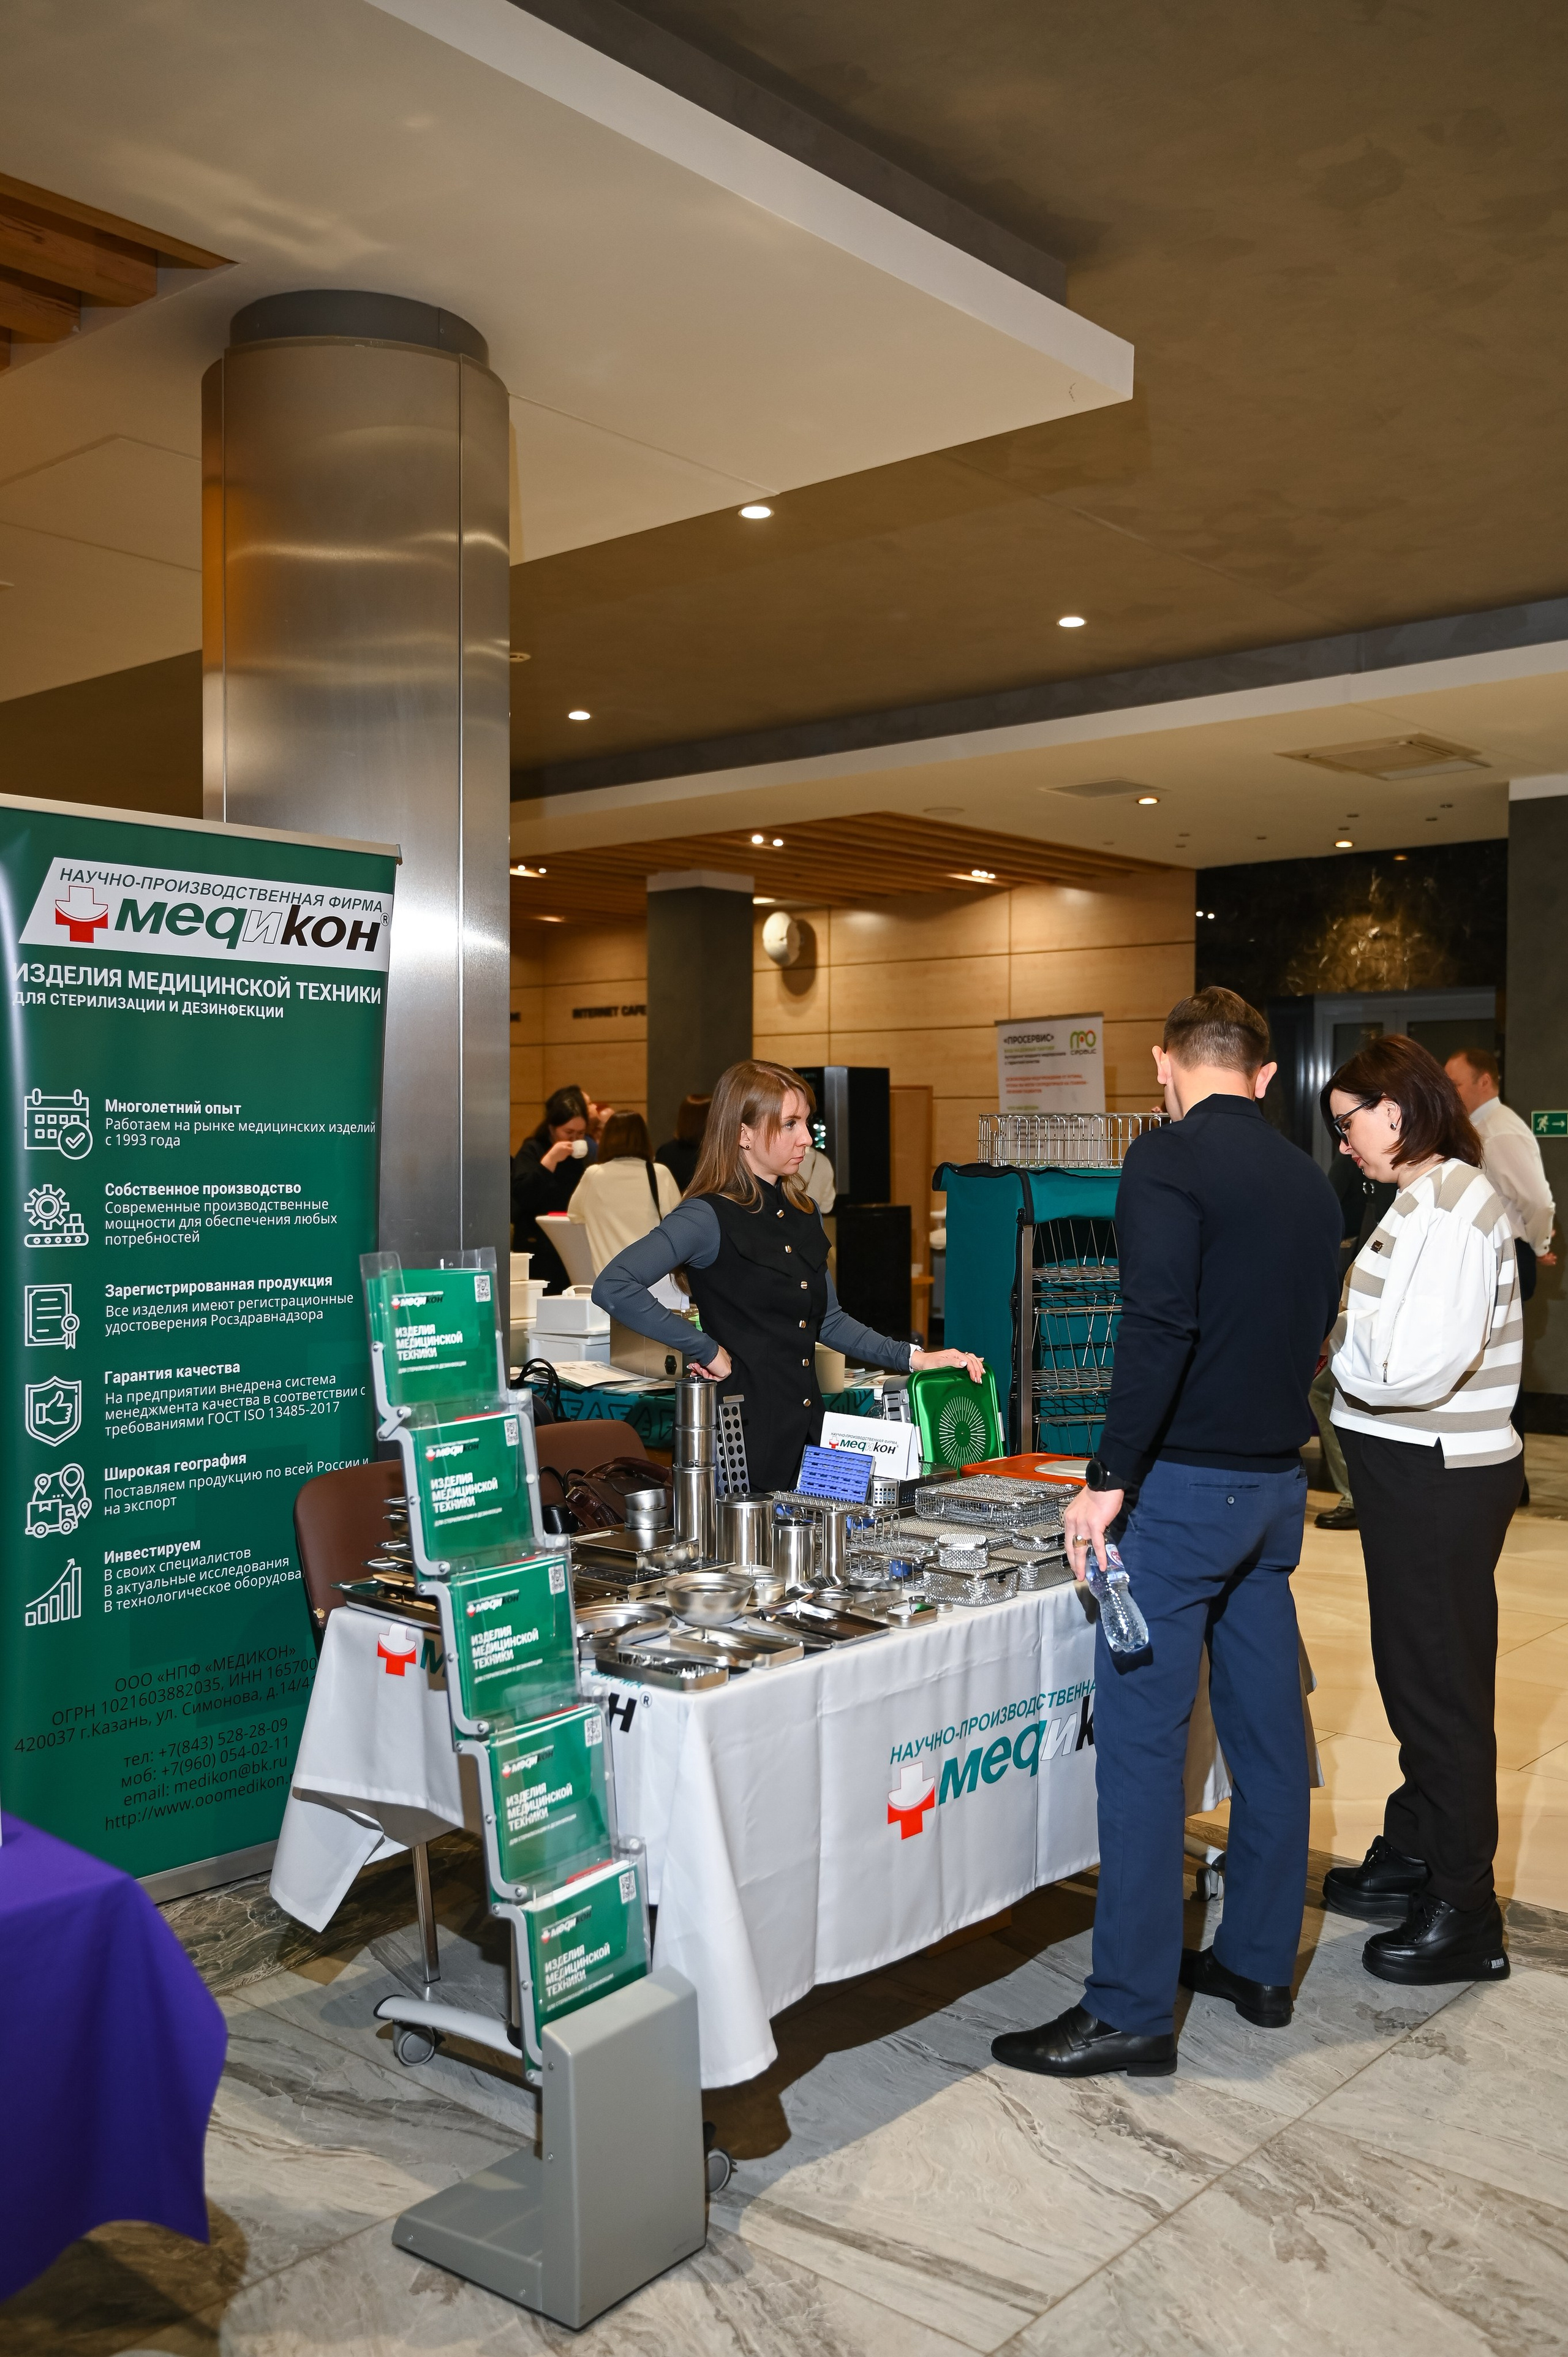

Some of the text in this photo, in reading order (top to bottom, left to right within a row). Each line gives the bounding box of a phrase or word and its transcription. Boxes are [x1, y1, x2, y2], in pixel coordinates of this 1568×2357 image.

[60, 868, 382, 913] НАУЧНО-ПРОИЗВОДСТВЕННАЯ ФИРМА
[13, 963, 380, 1004] ИЗДЕЛИЯ МЕДИЦИНСКОЙ ТЕХНИКИ
[12, 992, 283, 1019] ДЛЯ СТЕРИЛИЗАЦИИ И ДЕЗИНФЕКЦИИ
[105, 1099, 241, 1114] Многолетний опыт
[106, 1118, 375, 1135] Работаем на рынке медицинских изделий
[105, 1134, 180, 1148] с 1993 года
[105, 1182, 301, 1197] Собственное производство
[105, 1201, 328, 1216] Современные производственные
[105, 1213, 337, 1231] мощности для обеспечения любых
[105, 1231, 199, 1248] потребностей
[105, 1277, 332, 1299] Зарегистрированная продукция
[107, 1294, 353, 1317] Все изделия имеют регистрационные
[105, 1311, 323, 1337] удостоверения Росздравнадзора
[395, 1324, 435, 1338] ИЗДЕЛИЯ
[396, 1331, 463, 1350] МЕДИЦИНСКОЙ
[397, 1347, 437, 1361] ТЕХНИКИ
[105, 1363, 240, 1386] Гарантия качества
[106, 1375, 336, 1405] На предприятии внедрена система
[106, 1387, 365, 1420] менеджмента качества в соответствии с
[105, 1401, 339, 1439] требованиями ГОСТ ISO 13485-2017
[105, 1453, 246, 1481] Широкая география
[105, 1480, 184, 1499] Поставляем
[189, 1471, 262, 1490] продукцию
[266, 1468, 281, 1478] по
[285, 1461, 313, 1476] всей
[317, 1459, 359, 1472] России
[431, 1472, 473, 1490] ИЗДЕЛИЯ
[432, 1477, 499, 1501] МЕДИЦИНСКОЙ
[105, 1497, 177, 1515] на экспорт
[433, 1496, 475, 1514] ТЕХНИКИ
[105, 1540, 200, 1564] Инвестируем
[105, 1549, 251, 1581] В своих специалистов
[105, 1558, 288, 1597] В актуальные исследования
[105, 1571, 304, 1612] В технологическое оборудова
[471, 1625, 512, 1646] ИЗДЕЛИЯ
[472, 1627, 539, 1657] МЕДИЦИНСКОЙ
[115, 1645, 295, 1692] ООО «НПФ «МЕДИКОН»
[473, 1649, 514, 1670] ТЕХНИКИ
[52, 1657, 317, 1725] ОГРН 1021603882035, ИНН 165700
[15, 1727, 75, 1752] 420037
[81, 1716, 151, 1739] г.Казань,
[156, 1709, 177, 1726] ул.
[183, 1691, 262, 1716] Симонова,
[124, 1718, 287, 1768] тел: +7(843) 528-28-09
[122, 1735, 287, 1788] моб: +7(960) 054-02-11
[124, 1757, 287, 1806] email: medikon@bk.ru
[506, 1782, 547, 1807] ИЗДЕЛИЯ
[507, 1782, 573, 1820] МЕДИЦИНСКОЙ
[508, 1807, 549, 1831] ТЕХНИКИ
[545, 1944, 584, 1972] ИЗДЕЛИЯ
[545, 1942, 611, 1985] МЕДИЦИНСКОЙ
[546, 1969, 586, 1997] ТЕХНИКИ
